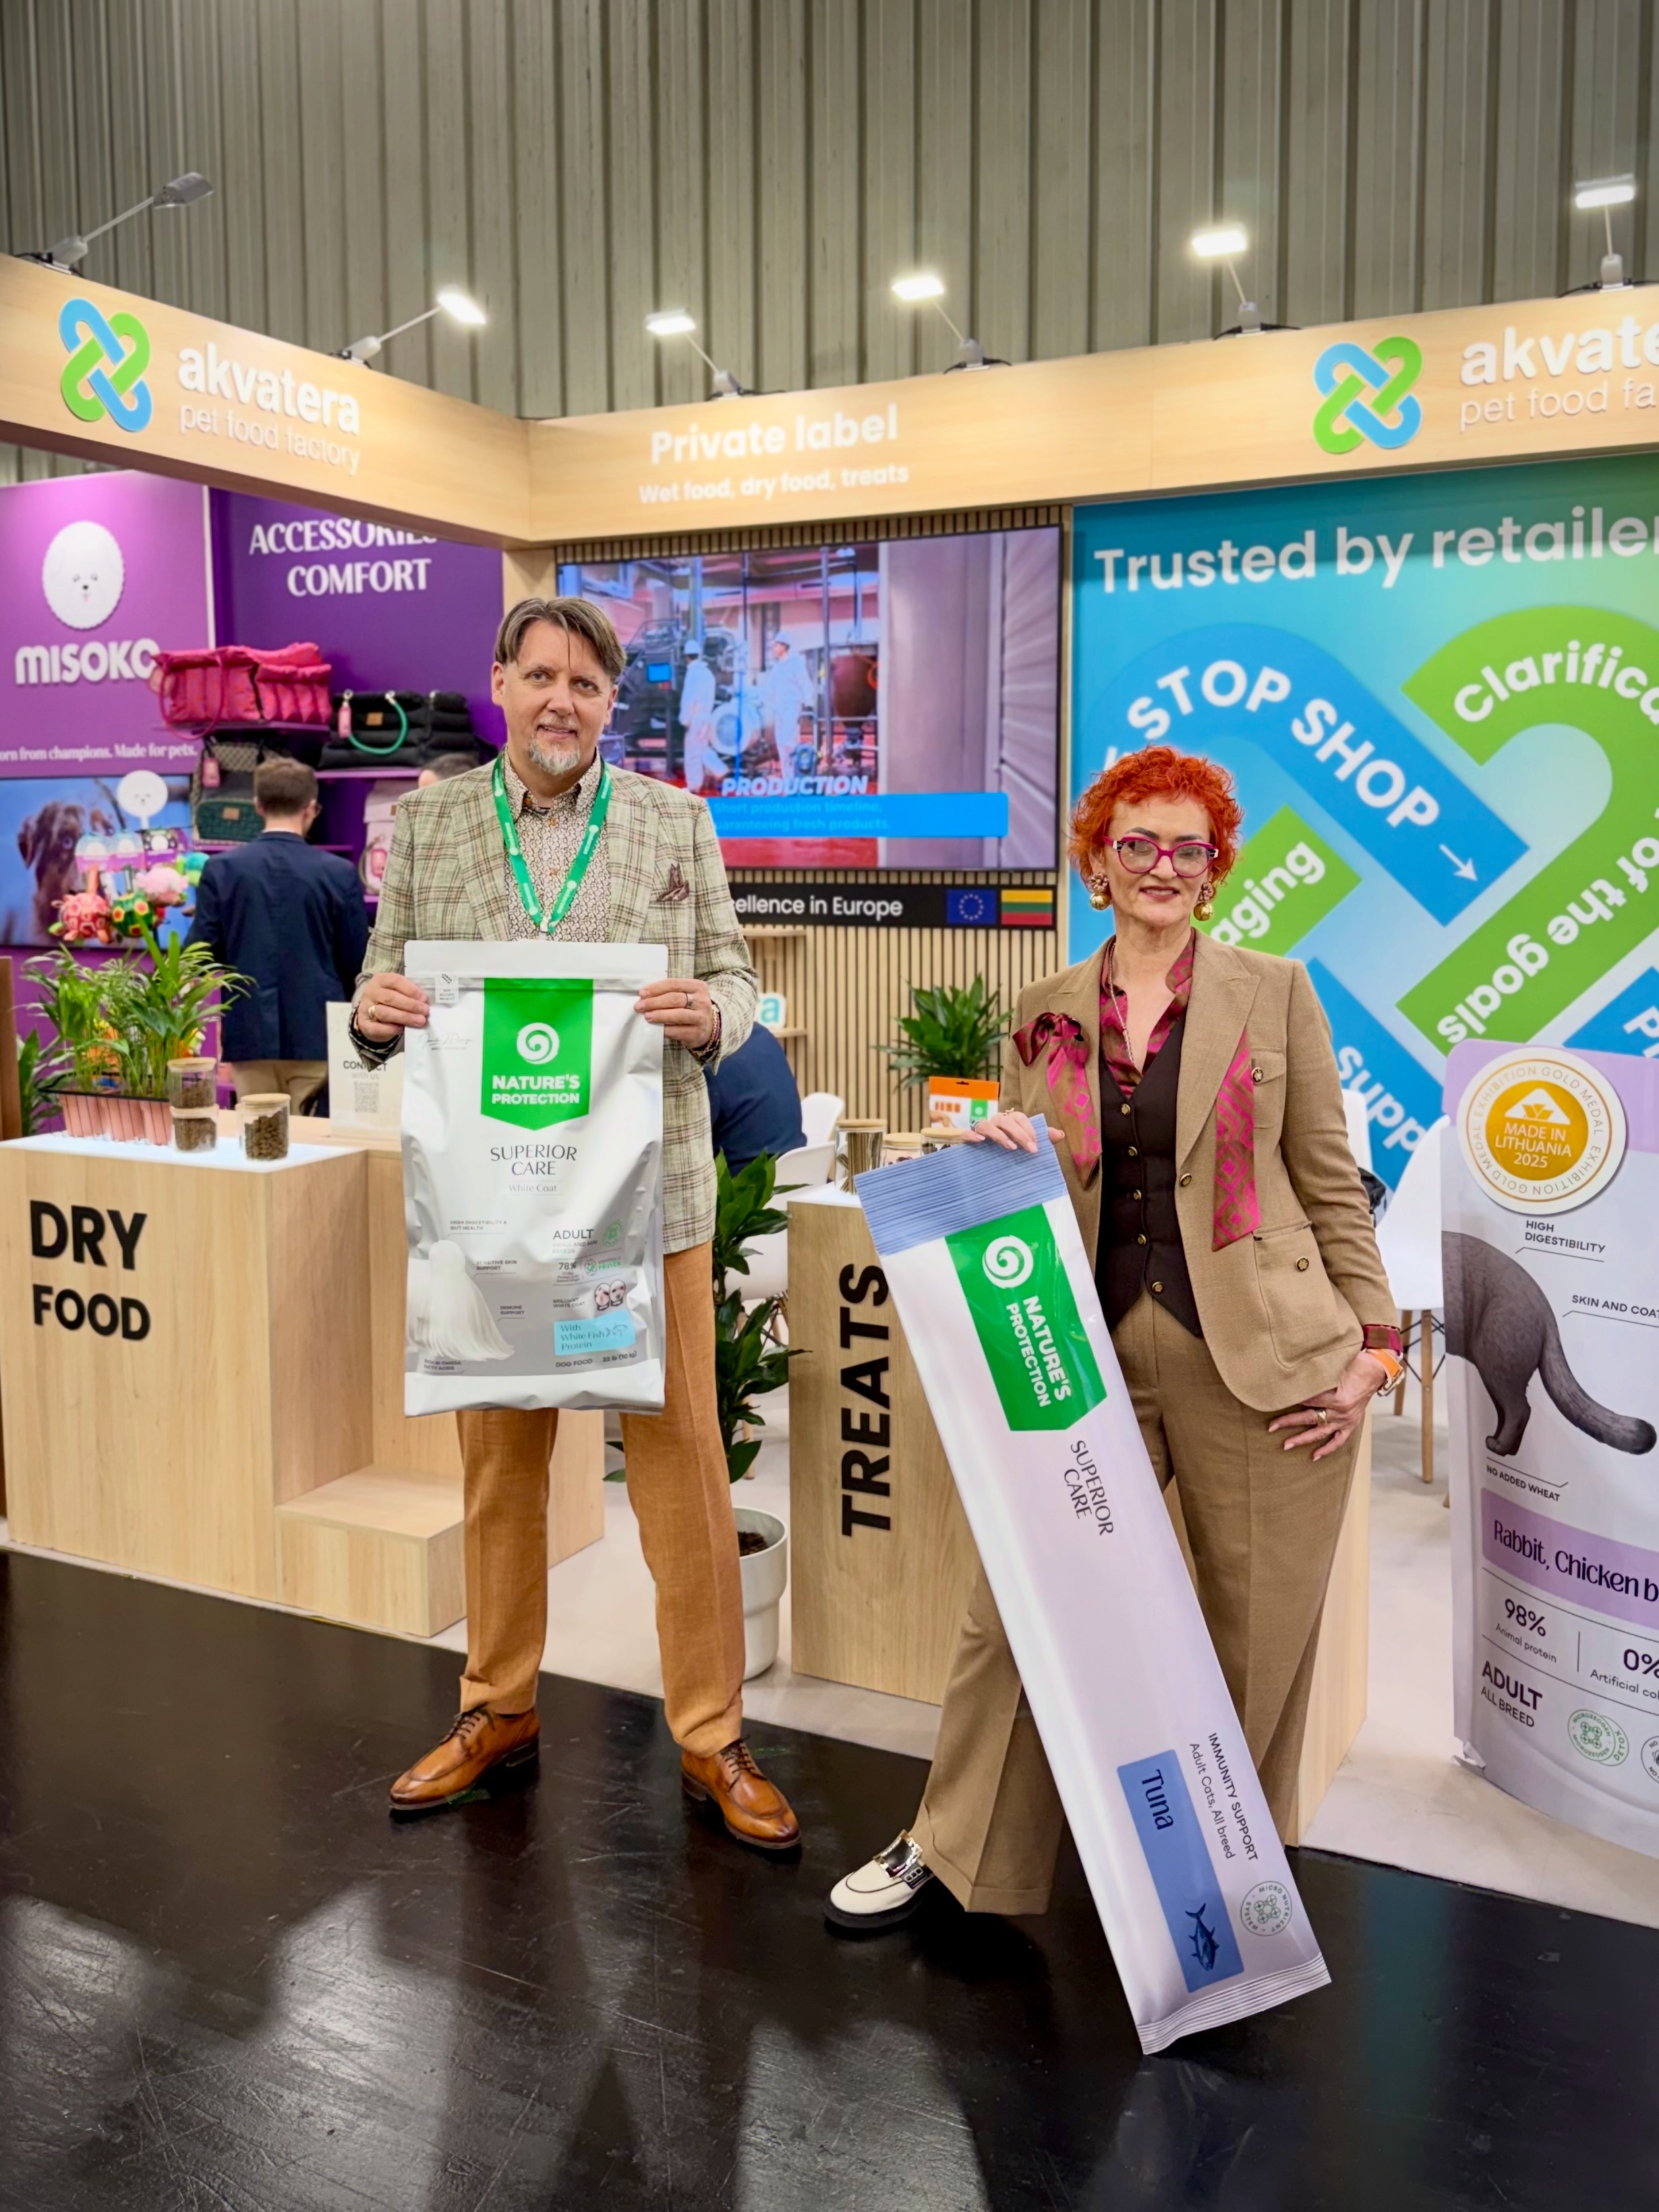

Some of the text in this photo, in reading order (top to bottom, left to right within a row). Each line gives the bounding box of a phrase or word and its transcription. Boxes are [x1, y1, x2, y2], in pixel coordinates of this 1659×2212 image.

[178, 341, 359, 436] akvatera
[1459, 392, 1515, 433] pet
[1527, 380, 1608, 418] food
[180, 405, 359, 476] pet food factory
[651, 403, 898, 465] Private label
[639, 464, 909, 505] Wet food, dry food, treats
[249, 517, 437, 555] ACCESSORI
[287, 558, 432, 597] COMFORT
[1095, 530, 1316, 593] Trusted
[1337, 527, 1414, 589] by
[20, 746, 47, 761] from
[49, 744, 113, 763] champions.
[114, 743, 147, 759] Made
[148, 741, 167, 758] for
[169, 744, 198, 760] pets.
[1127, 660, 1439, 827] STOP SHOP
[722, 776, 869, 796] PRODUCTION
[714, 803, 747, 813] Short
[751, 801, 825, 815] production
[793, 818, 825, 830] fresh
[829, 817, 892, 831] products.
[731, 895, 903, 922] ellence in Europe
[1437, 837, 1659, 1043] of the goals
[343, 1061, 388, 1071] CONCT
[492, 1074, 580, 1090] NATURE'S
[492, 1093, 580, 1105] PROTECTION
[1474, 1066, 1604, 1135] EXHIBITION GOLD MEDAL
[1495, 1134, 1572, 1157] LITHUANIA
[1504, 1122, 1567, 1142] MADE IN
[490, 1144, 577, 1162] SUPERIOR
[511, 1161, 557, 1175] CARE
[1473, 1124, 1601, 1195] EXHIBITION GOLD MEDAL
[1513, 1152, 1548, 1169] 2025
[509, 1183, 557, 1192] White Coat
[30, 1199, 147, 1272] DRY
[553, 1229, 594, 1240] ADULT
[1525, 1219, 1554, 1233] HIGH
[1525, 1231, 1606, 1253] DIGESTIBILITY
[558, 1261, 577, 1271] 78%
[32, 1283, 150, 1341] FOOD
[1572, 1294, 1599, 1308] SKIN
[1602, 1300, 1627, 1312] AND
[560, 1323, 581, 1333] With
[560, 1331, 605, 1341] White Fish
[561, 1341, 592, 1351] Protein
[573, 1358, 593, 1366] FOOD
[1006, 1302, 1051, 1407] PROTECTION
[1023, 1295, 1072, 1401] NATURE'S
[839, 1264, 891, 1537] TREATS
[1064, 1468, 1093, 1519] CARE
[1070, 1440, 1113, 1536] SUPERIOR
[1486, 1465, 1561, 1503] NO ADDED WHEAT
[1494, 1519, 1550, 1571] Rabbit,
[1554, 1550, 1639, 1598] Chicken
[1505, 1598, 1546, 1637] 98%
[1496, 1623, 1557, 1664] Animal protein
[1482, 1660, 1543, 1710] ADULT
[1590, 1669, 1639, 1693] Artificial
[1481, 1686, 1535, 1728] ALL BREED
[1614, 1730, 1626, 1761] DETOX
[1142, 1769, 1173, 1831] Tuna
[1189, 1743, 1236, 1859] Adult Cats, All breed
[1208, 1733, 1258, 1861] IMMUNITY SUPPORT
[1244, 1901, 1258, 1930] SYSTEM
[1258, 1884, 1289, 1932] MICRO NUTRIENT
